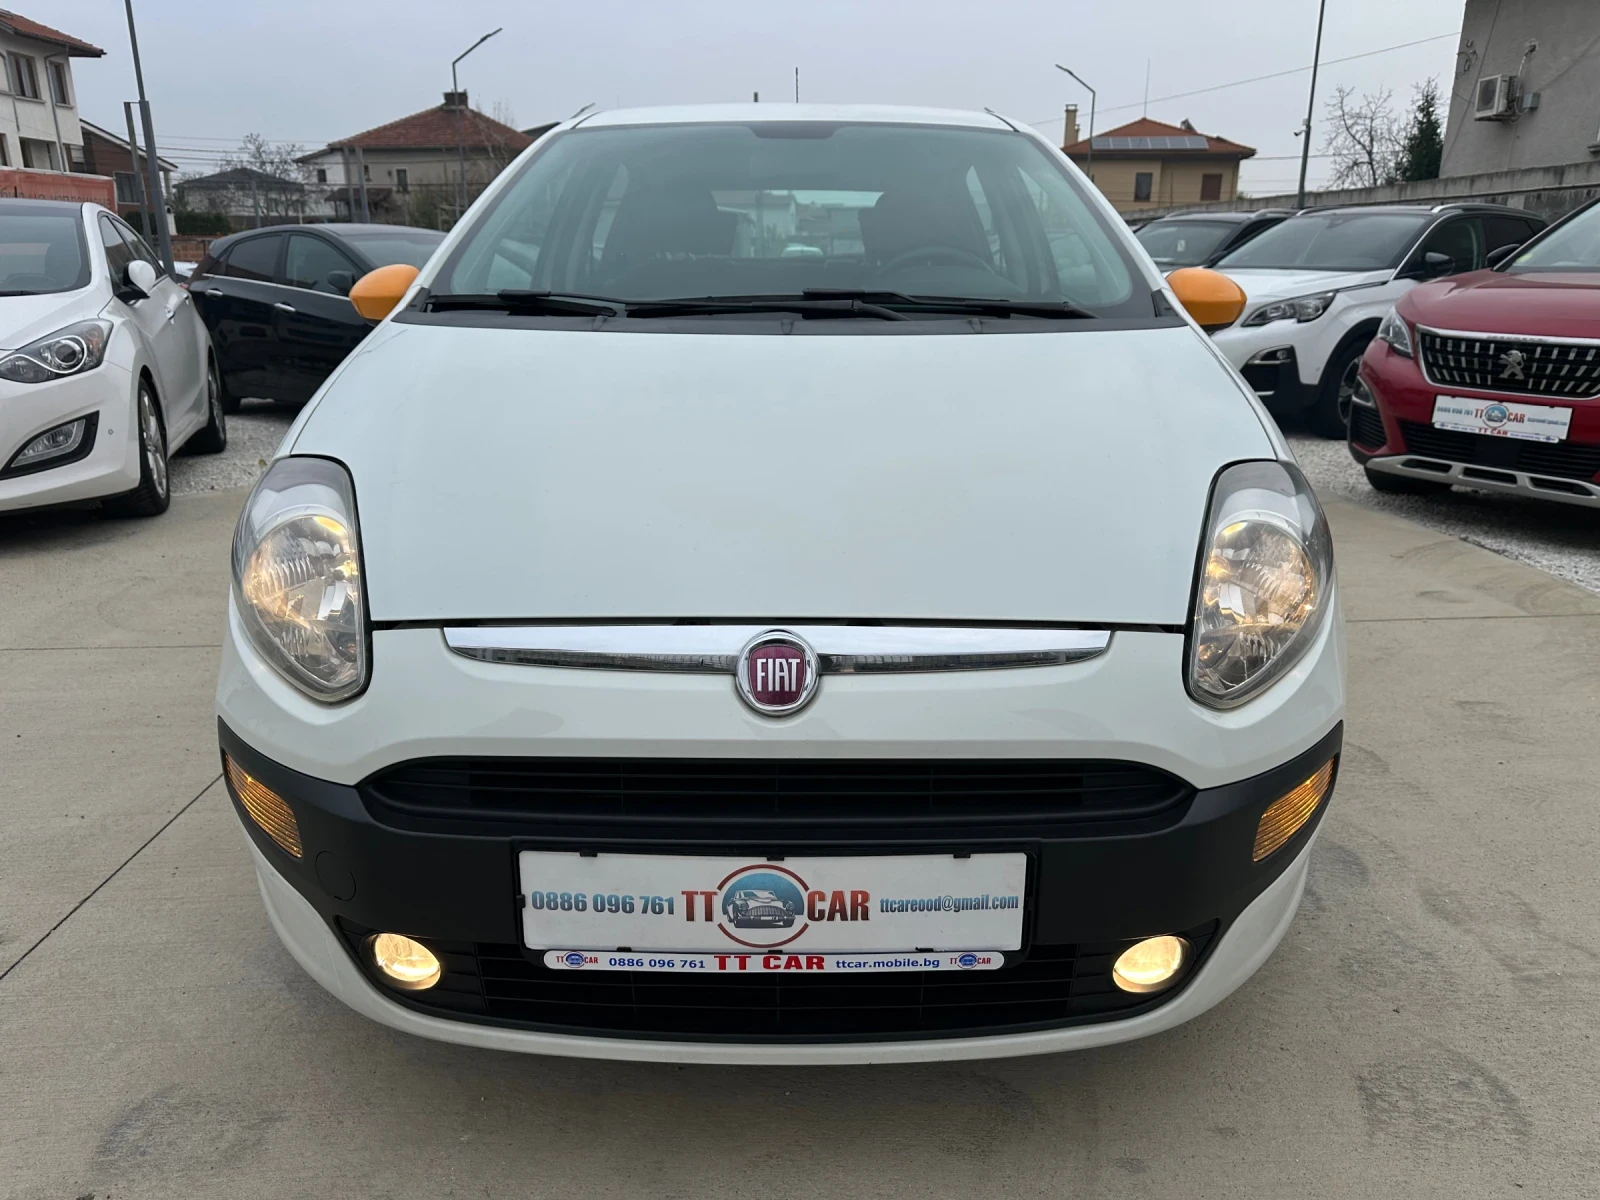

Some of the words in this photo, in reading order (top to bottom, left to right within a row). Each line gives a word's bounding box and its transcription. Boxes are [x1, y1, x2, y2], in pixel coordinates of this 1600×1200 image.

[1474, 408, 1484, 419] TT
[1507, 411, 1526, 424] CAR
[756, 658, 801, 692] FIAT
[531, 890, 588, 912] 0886
[592, 893, 635, 914] 096
[639, 895, 675, 915] 761
[681, 890, 719, 922] TT
[806, 890, 871, 922] CAR
[879, 894, 1019, 914] ttcareood@gmail.com
[583, 956, 599, 964] CAR
[608, 957, 645, 967] 0886
[648, 958, 676, 968] 096
[680, 959, 706, 969] 761
[713, 955, 752, 971] TT
[762, 955, 825, 970] CAR
[835, 957, 940, 968] ttcar.mobile.bg
[949, 957, 958, 965] TT
[977, 957, 992, 965] CAR
